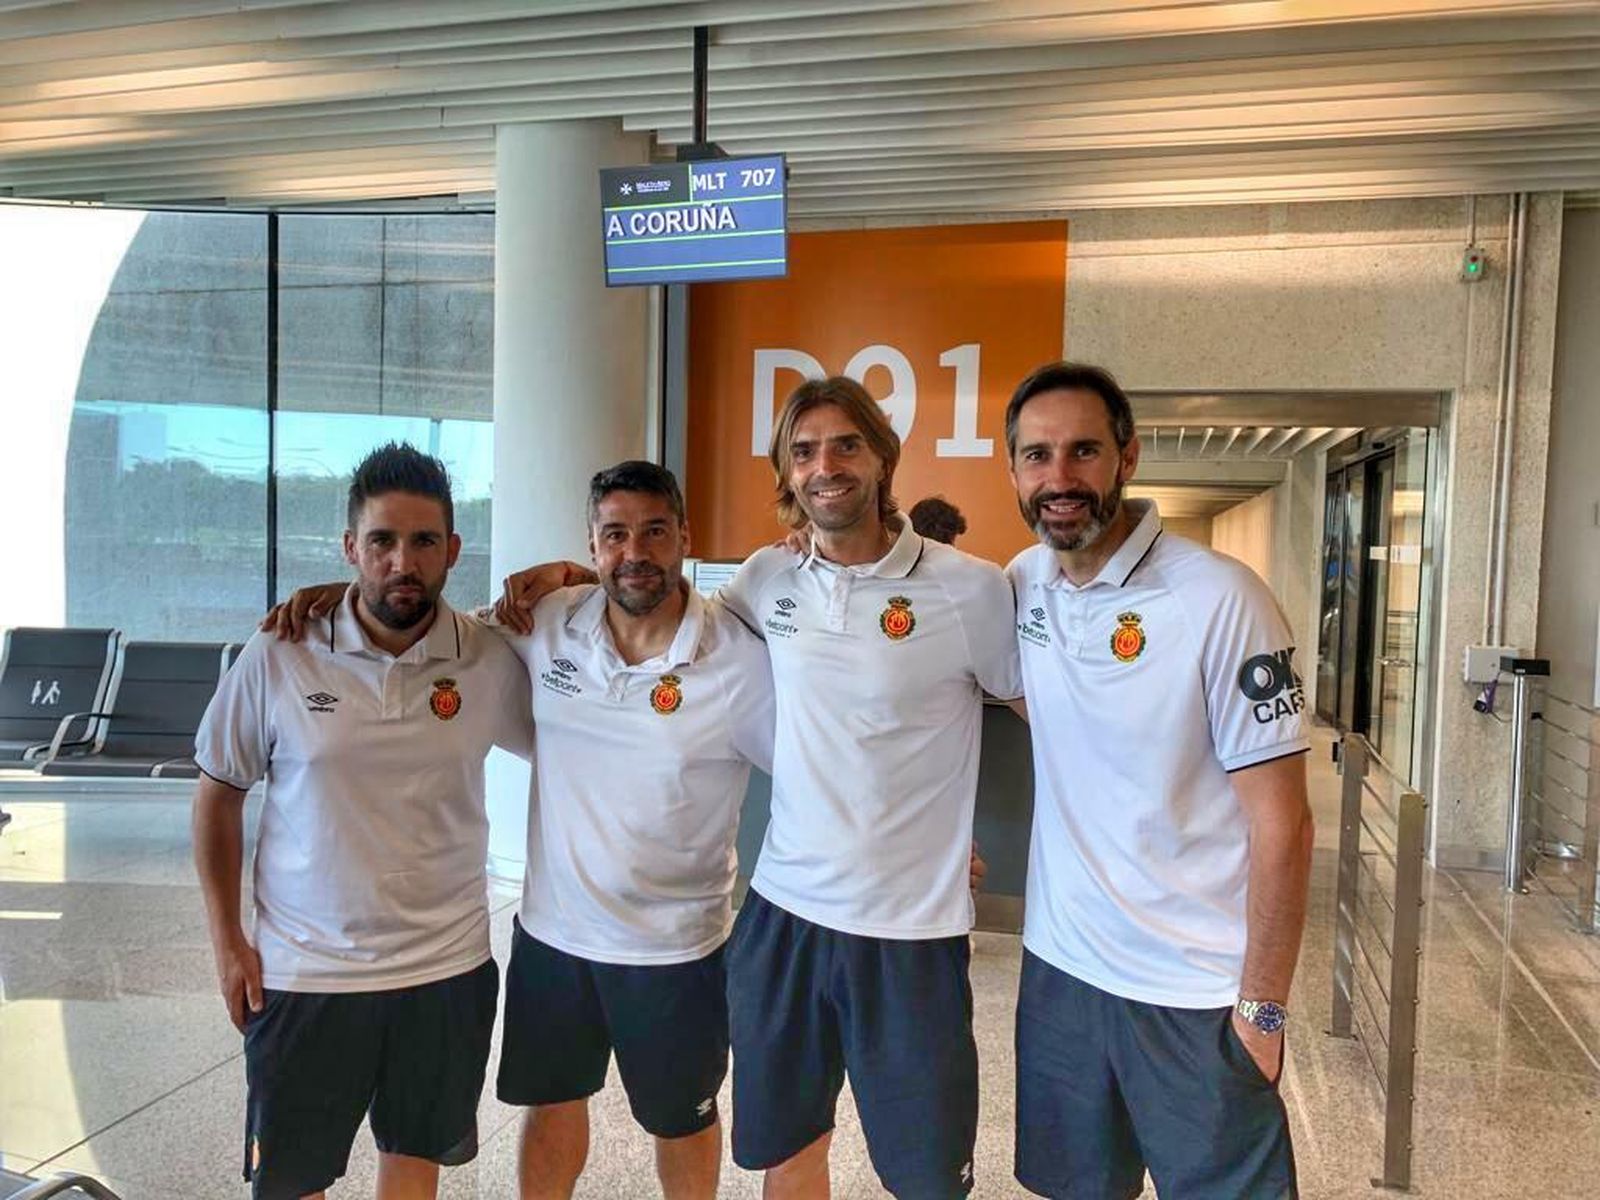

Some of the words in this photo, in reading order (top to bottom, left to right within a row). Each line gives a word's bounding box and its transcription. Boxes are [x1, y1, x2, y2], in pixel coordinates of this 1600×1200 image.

[692, 173, 727, 191] MLT
[740, 168, 776, 187] 707
[606, 214, 625, 238] A
[630, 202, 737, 236] CORUÑA
[751, 344, 995, 457] D91
